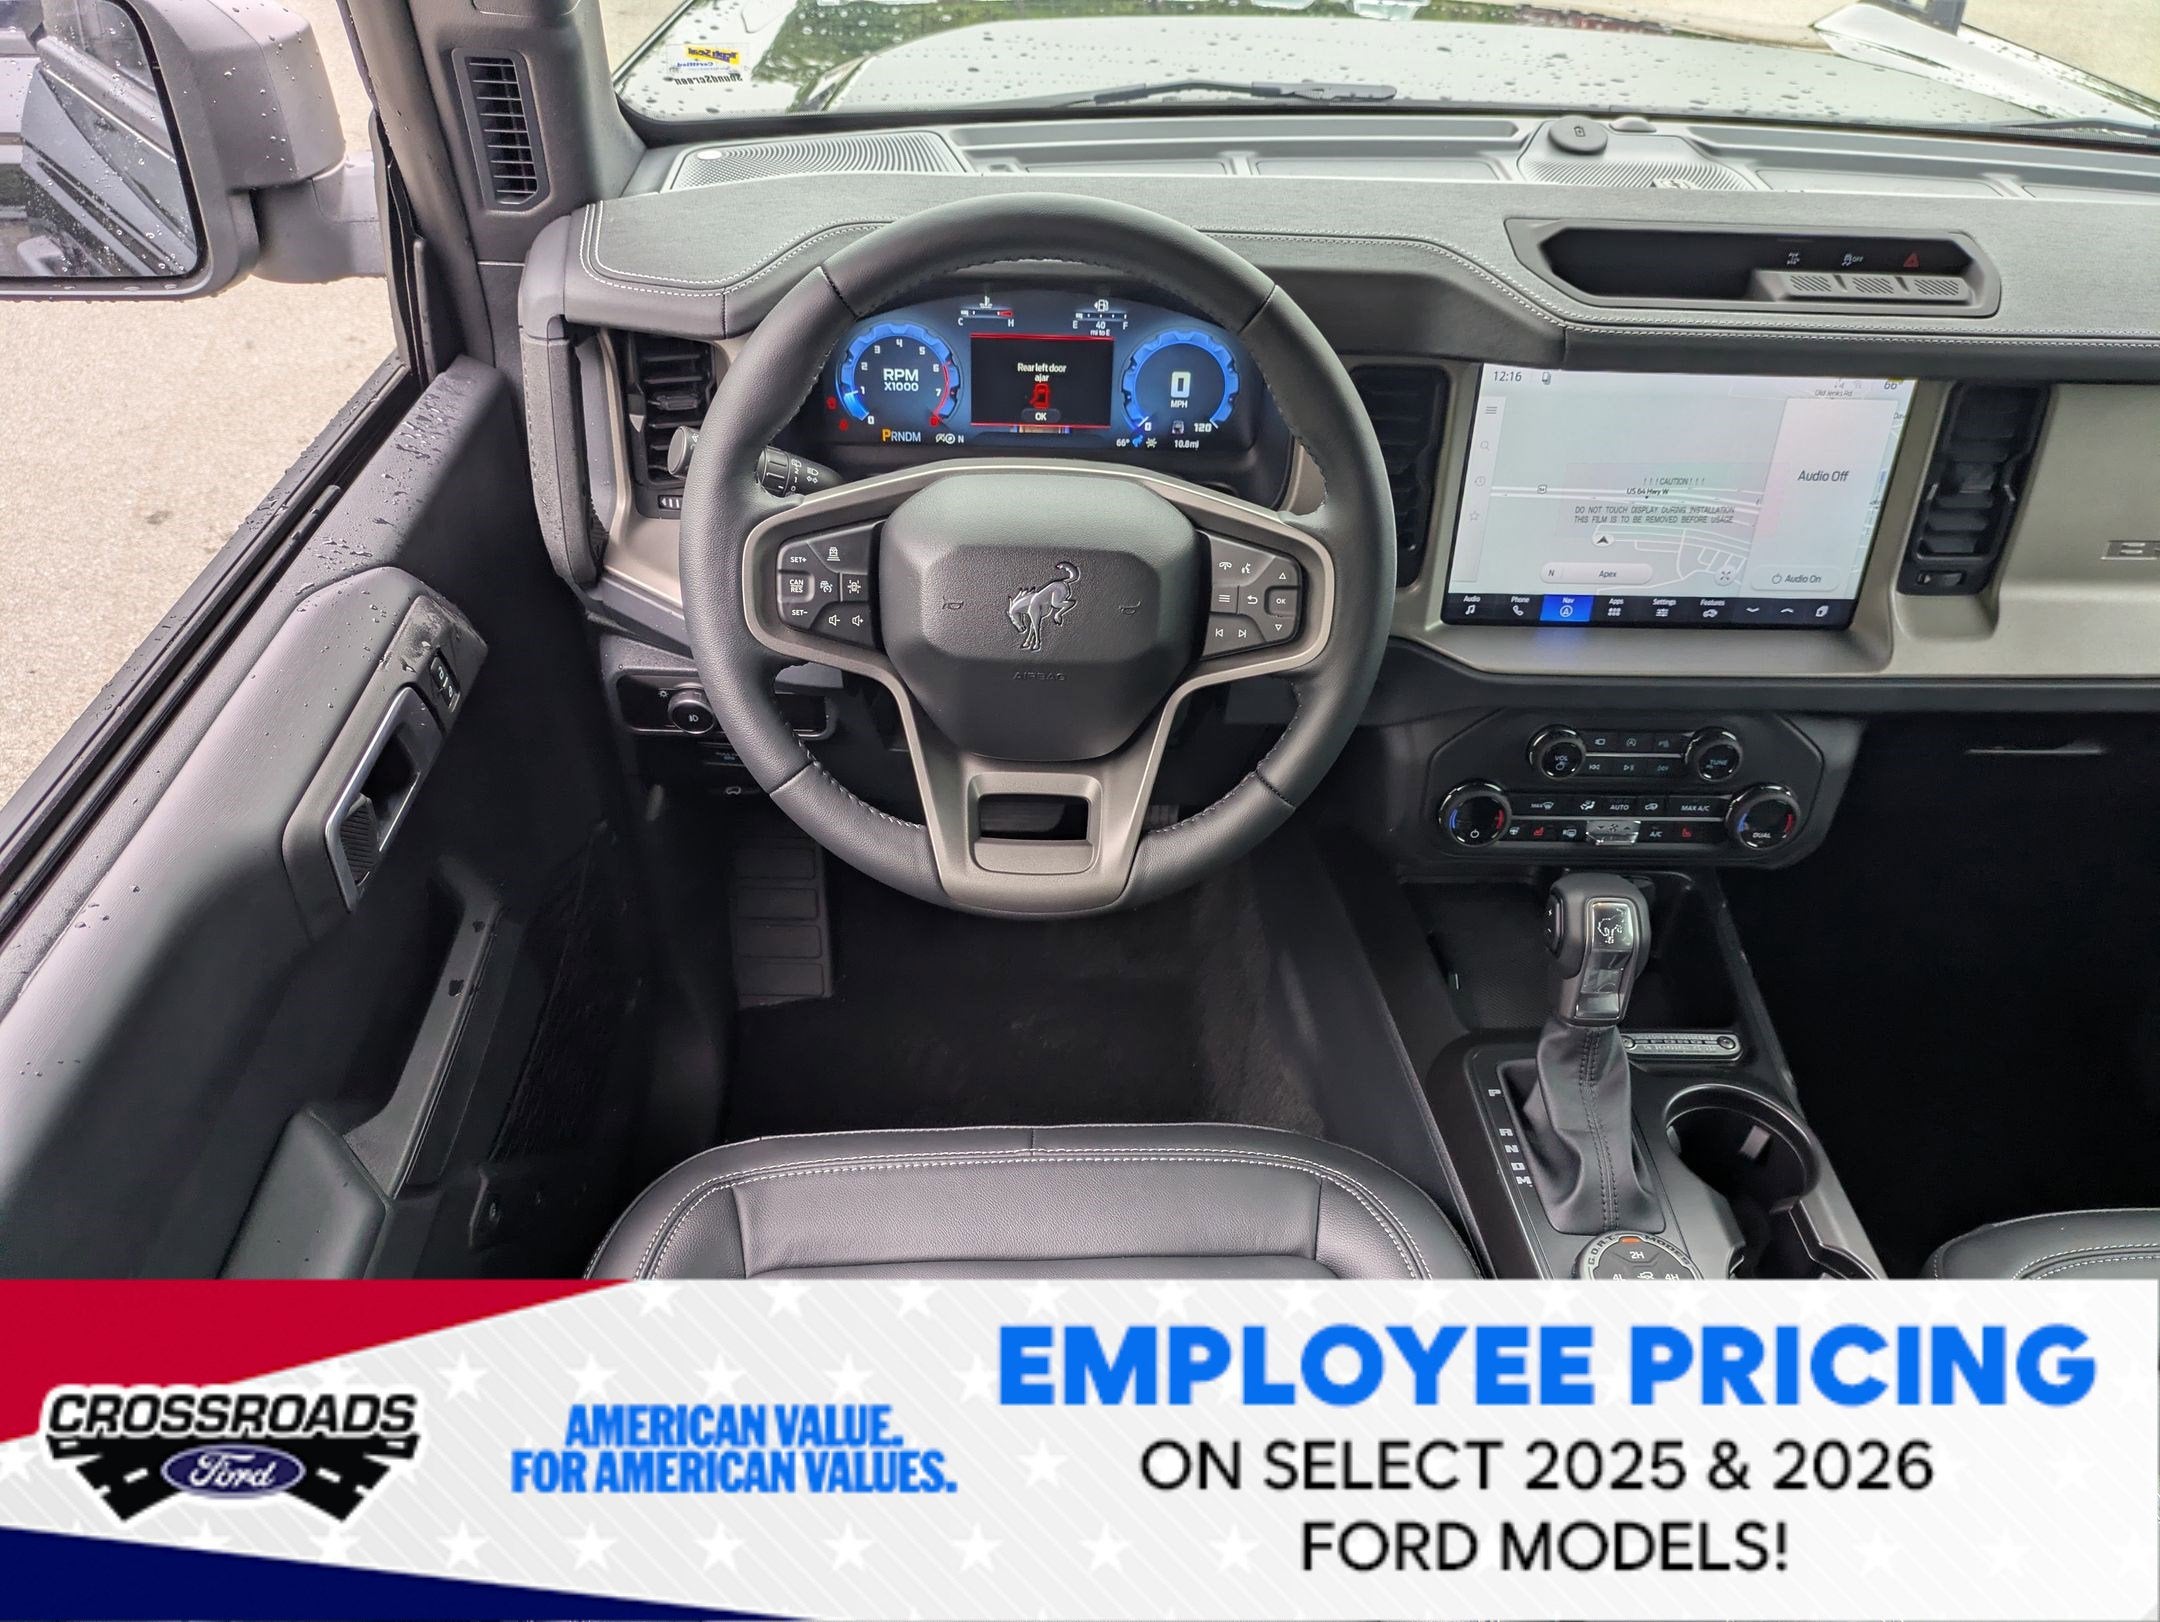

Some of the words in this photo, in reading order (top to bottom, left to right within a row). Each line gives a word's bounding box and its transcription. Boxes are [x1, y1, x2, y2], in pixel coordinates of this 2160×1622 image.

[957, 317, 964, 326] C
[1007, 319, 1015, 328] H
[1072, 320, 1079, 330] E
[1095, 321, 1107, 330] 40
[1122, 321, 1129, 330] F
[895, 339, 903, 347] 4
[874, 345, 881, 354] 3
[919, 346, 926, 355] 5
[861, 362, 868, 371] 2
[932, 363, 940, 373] 6
[1017, 362, 1035, 372] Rear
[1035, 363, 1049, 372] left
[1049, 363, 1067, 373] door
[883, 368, 919, 382] RPM
[1034, 373, 1050, 383] ajar
[1493, 371, 1522, 382] 12:16
[884, 382, 919, 392] X1000
[1170, 371, 1191, 398] 0
[935, 388, 942, 397] 7
[1170, 400, 1188, 409] MPH
[867, 416, 875, 425] 0
[1035, 412, 1047, 421] OK
[1144, 422, 1152, 432] 0
[1194, 422, 1212, 433] 120
[882, 428, 921, 442] PRNDM
[957, 435, 965, 443] N
[1797, 470, 1830, 482] Audio
[1831, 470, 1850, 482] Off
[1626, 487, 1636, 495] US
[1574, 506, 1586, 514] DO
[1588, 506, 1602, 514] NOT
[1605, 506, 1629, 514] TOUCH
[1631, 506, 1659, 514] DISPLAY
[1661, 506, 1687, 514] DURING
[1689, 506, 1735, 514] INSTALLATION
[1574, 515, 1589, 524] THIS
[1592, 515, 1608, 524] FILM
[1609, 515, 1618, 524] IS
[1621, 515, 1630, 524] TO
[1632, 515, 1643, 524] BE
[1645, 515, 1679, 524] REMOVED
[1680, 515, 1709, 524] BEFORE
[1547, 569, 1556, 577] N
[1598, 570, 1617, 578] Apex
[1784, 573, 1808, 583] Audio
[1809, 574, 1822, 583] On
[1463, 595, 1481, 603] Audio
[1510, 596, 1530, 604] Phone
[1608, 598, 1624, 606] Apps
[1652, 598, 1677, 607] Settings
[1700, 599, 1725, 607] Features
[1012, 671, 1065, 681] AIRBAG
[1609, 803, 1630, 811] AUTO
[1680, 804, 1697, 812] MAX
[1697, 804, 1711, 812] A/C
[1649, 830, 1663, 838] A/C
[1488, 1089, 1502, 1097] P
[1504, 1144, 1520, 1153] N
[1510, 1162, 1526, 1171] D
[1515, 1175, 1532, 1185] M
[1629, 1250, 1646, 1260] 2H
